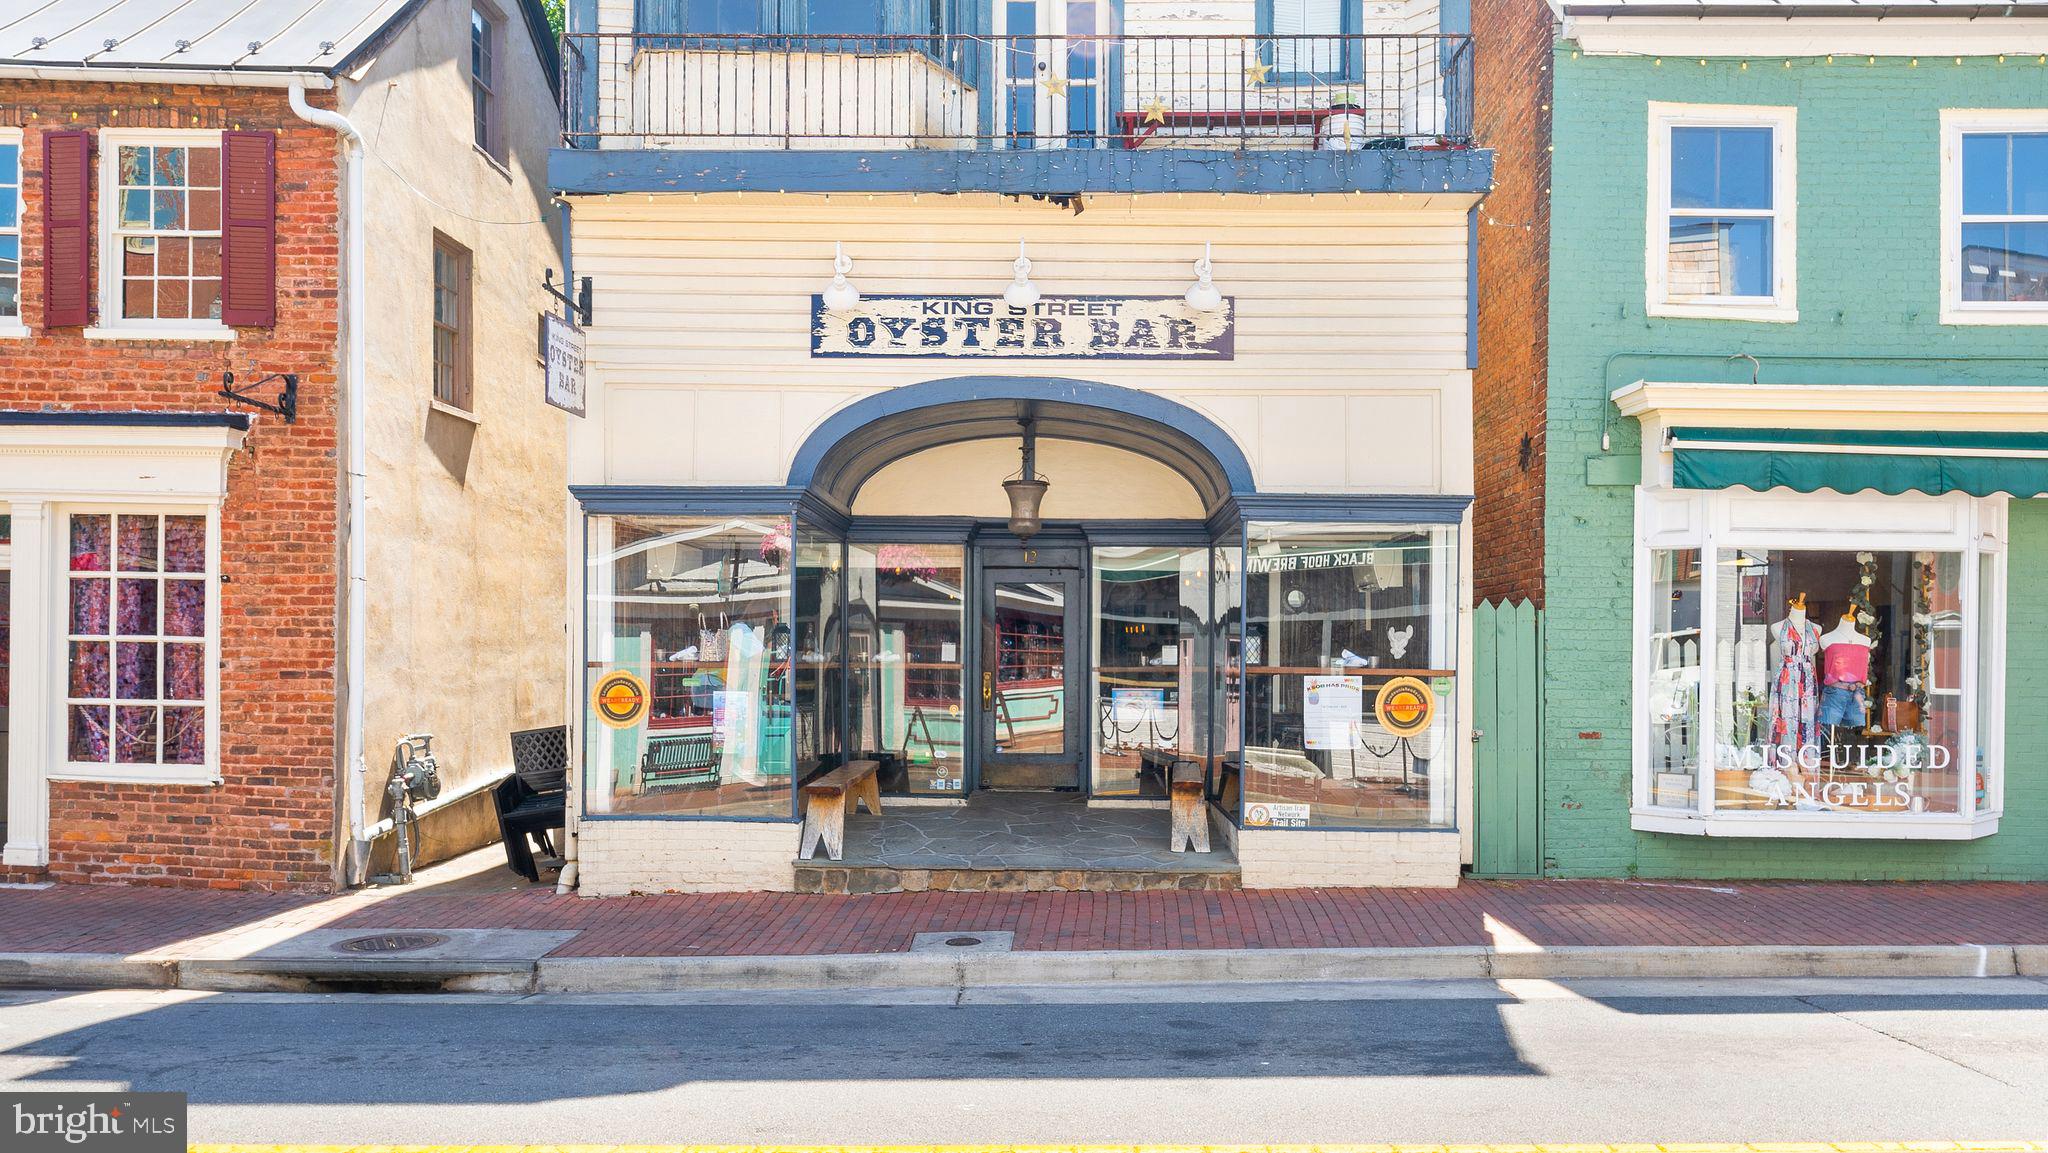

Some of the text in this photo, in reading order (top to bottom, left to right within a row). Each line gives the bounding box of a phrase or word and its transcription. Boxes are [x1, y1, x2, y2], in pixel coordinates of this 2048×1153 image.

[922, 302, 1122, 317] KING STREET
[845, 317, 1197, 350] OYSTER BAR
[550, 345, 584, 375] OYSTER
[559, 371, 576, 394] BAR
[1024, 550, 1038, 564] 12
[1728, 744, 1951, 769] MISGUIDED
[1764, 781, 1911, 807] ANGELS
[1272, 818, 1306, 827] Trail Site
